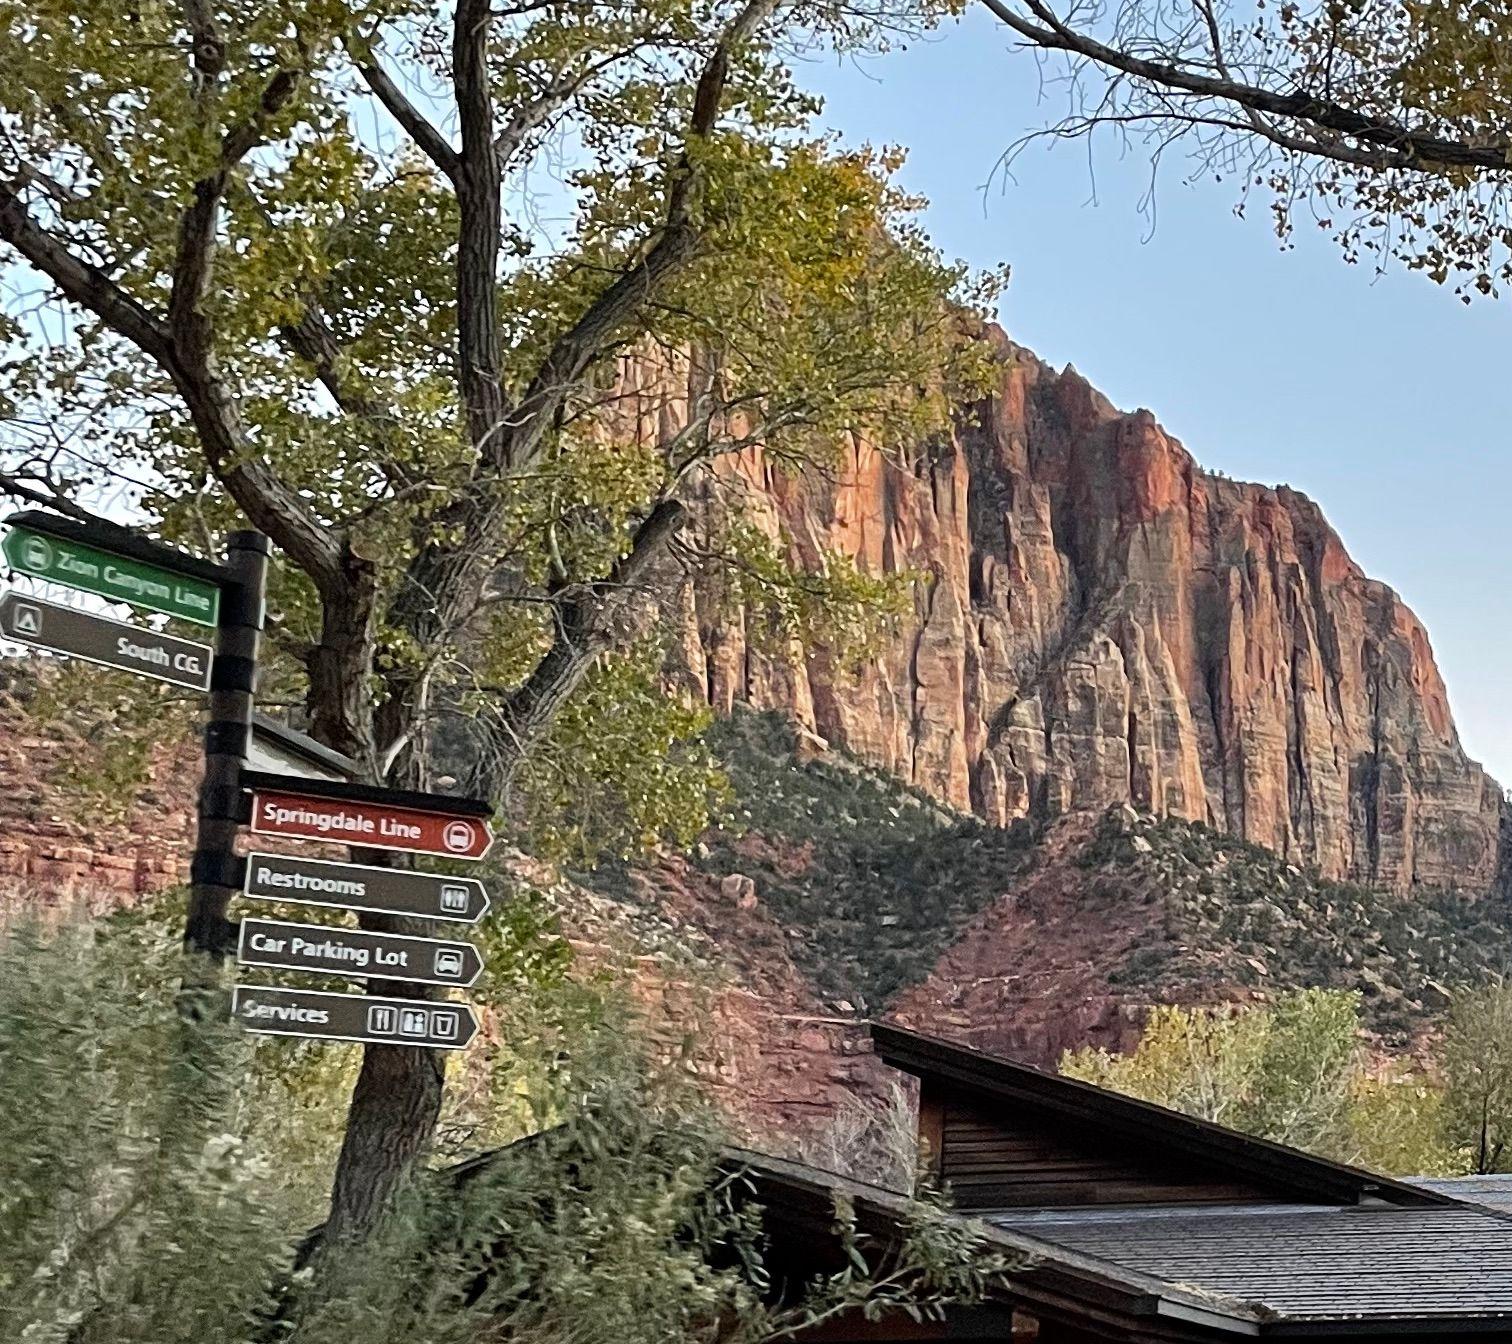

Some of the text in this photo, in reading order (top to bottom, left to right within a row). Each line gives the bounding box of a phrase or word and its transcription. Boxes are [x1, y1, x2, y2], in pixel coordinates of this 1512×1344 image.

[56, 551, 210, 611] Zion Canyon Line
[117, 637, 204, 675] South CG.
[263, 803, 422, 840] Springdale Line
[257, 867, 366, 896] Restrooms
[250, 933, 408, 967] Car Parking Lot
[242, 999, 329, 1024] Services
